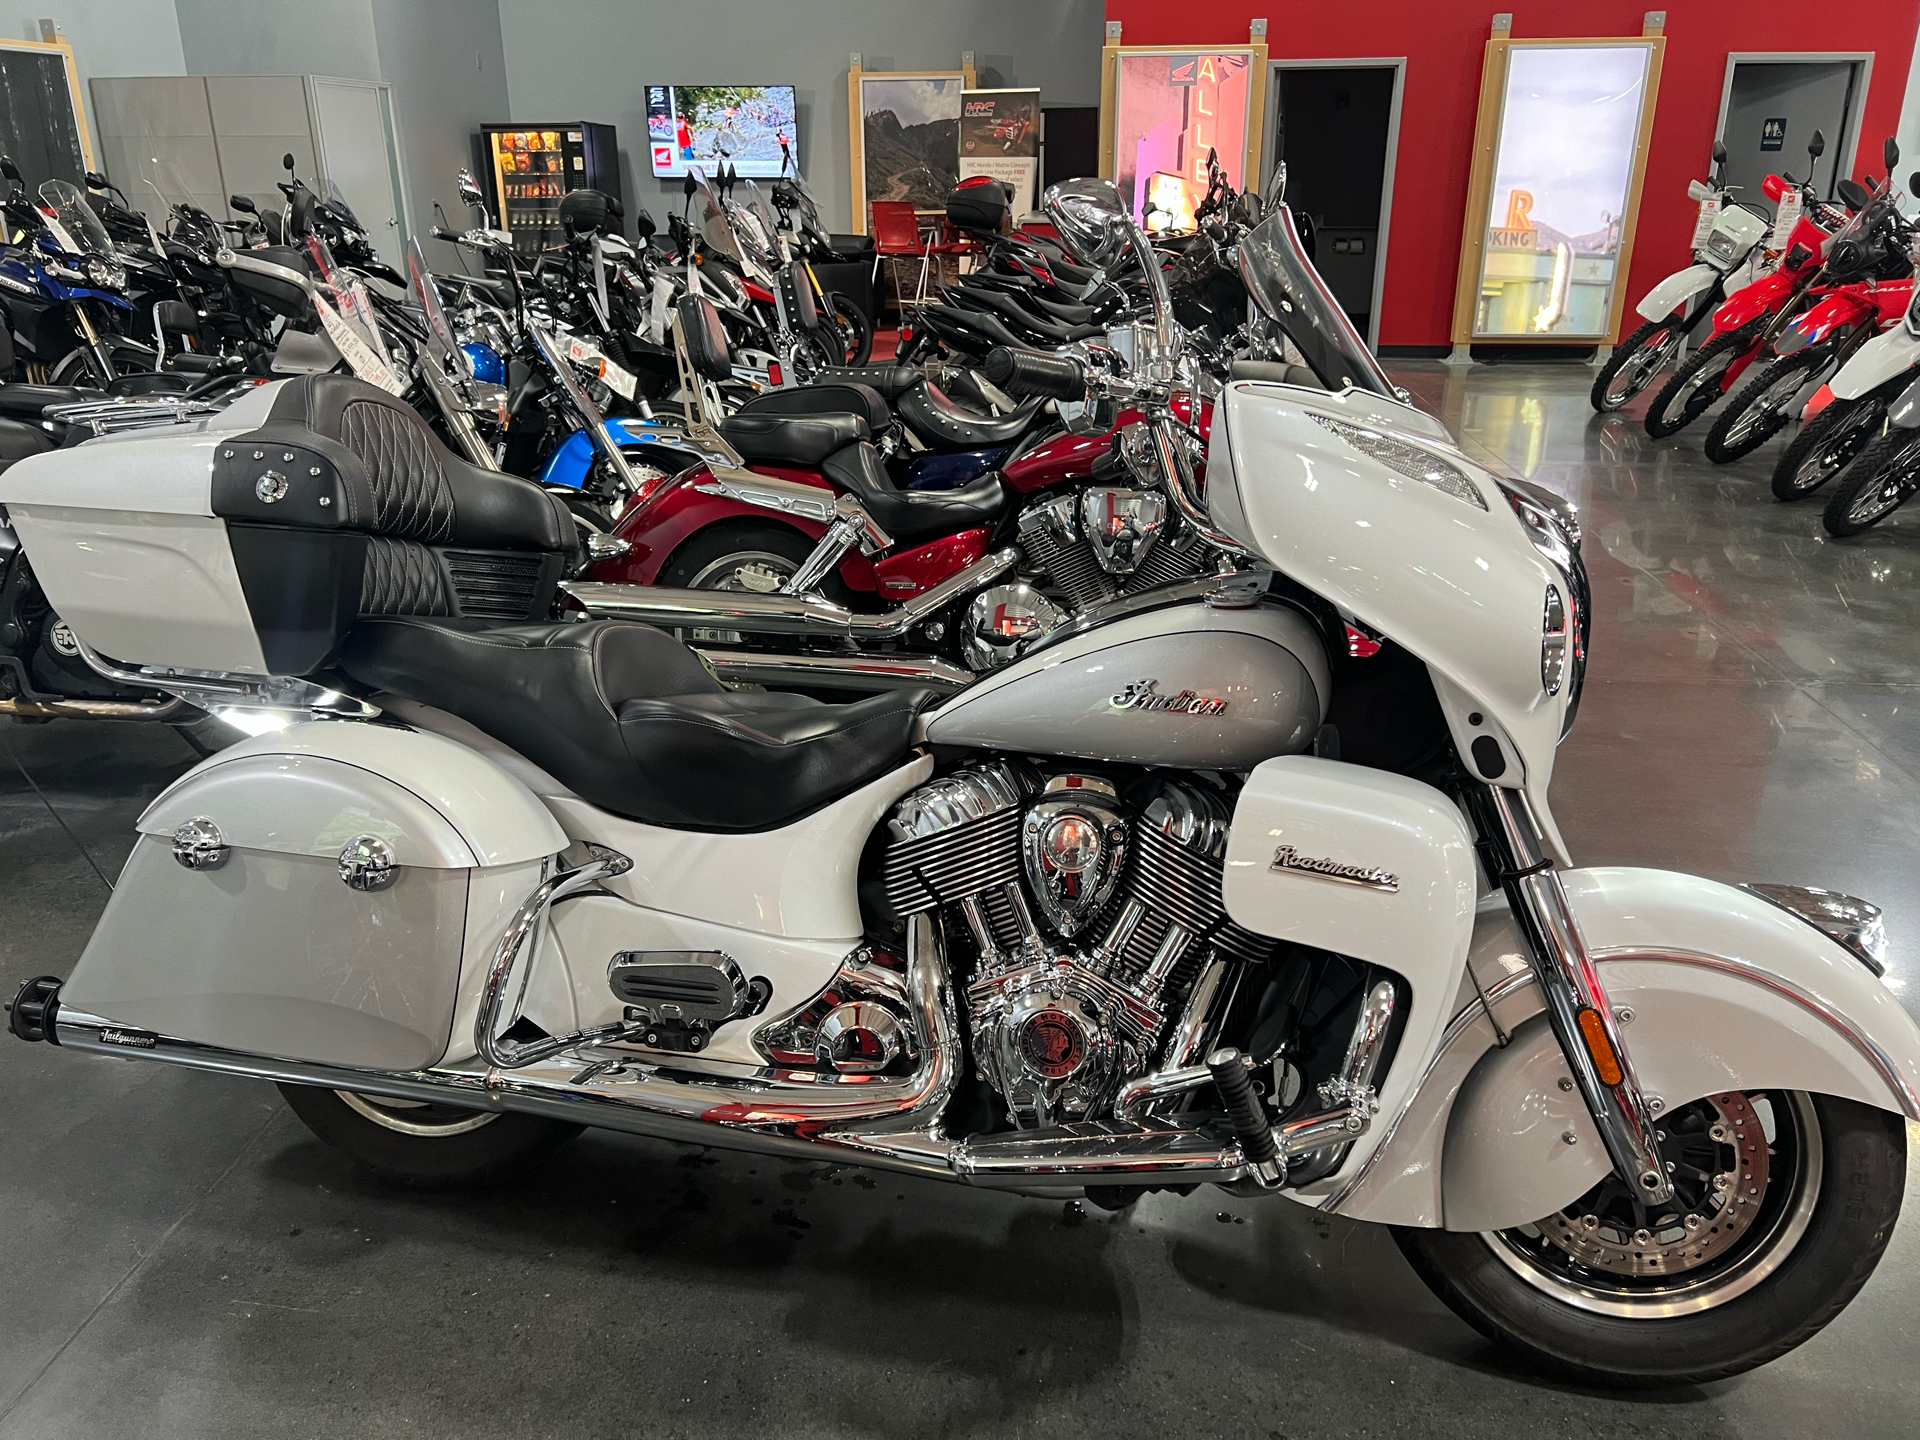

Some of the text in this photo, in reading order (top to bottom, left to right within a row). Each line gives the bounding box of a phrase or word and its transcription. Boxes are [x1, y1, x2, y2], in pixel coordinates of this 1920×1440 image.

[965, 102, 996, 115] HRC
[1506, 189, 1534, 231] R
[1109, 679, 1228, 716] Indian
[1273, 844, 1399, 885] Roadmaster
[103, 1028, 150, 1044] Tailgunner
[1023, 1013, 1082, 1065] INDIAN MOTORCYCLE
